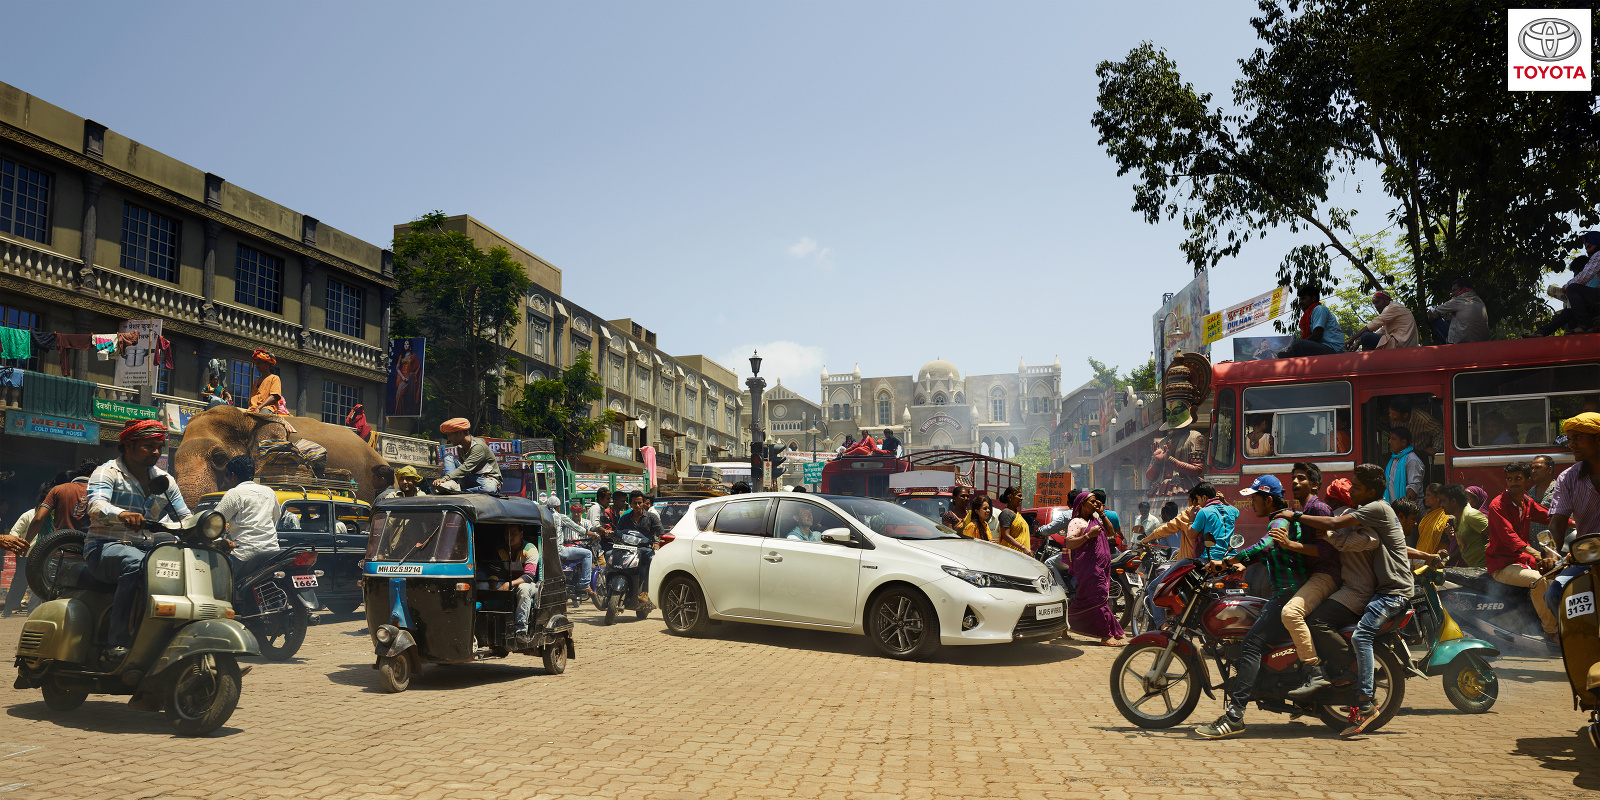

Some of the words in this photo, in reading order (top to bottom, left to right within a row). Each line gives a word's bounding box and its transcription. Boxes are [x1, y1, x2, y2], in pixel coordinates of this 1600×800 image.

[1207, 314, 1220, 324] SALE
[1227, 316, 1252, 330] DULHAN
[1208, 320, 1220, 331] SALE
[1208, 327, 1220, 338] SALE
[31, 417, 86, 431] MEENA
[1569, 595, 1590, 607] MXS
[1476, 603, 1505, 611] SPEED
[1567, 603, 1593, 616] 3137
